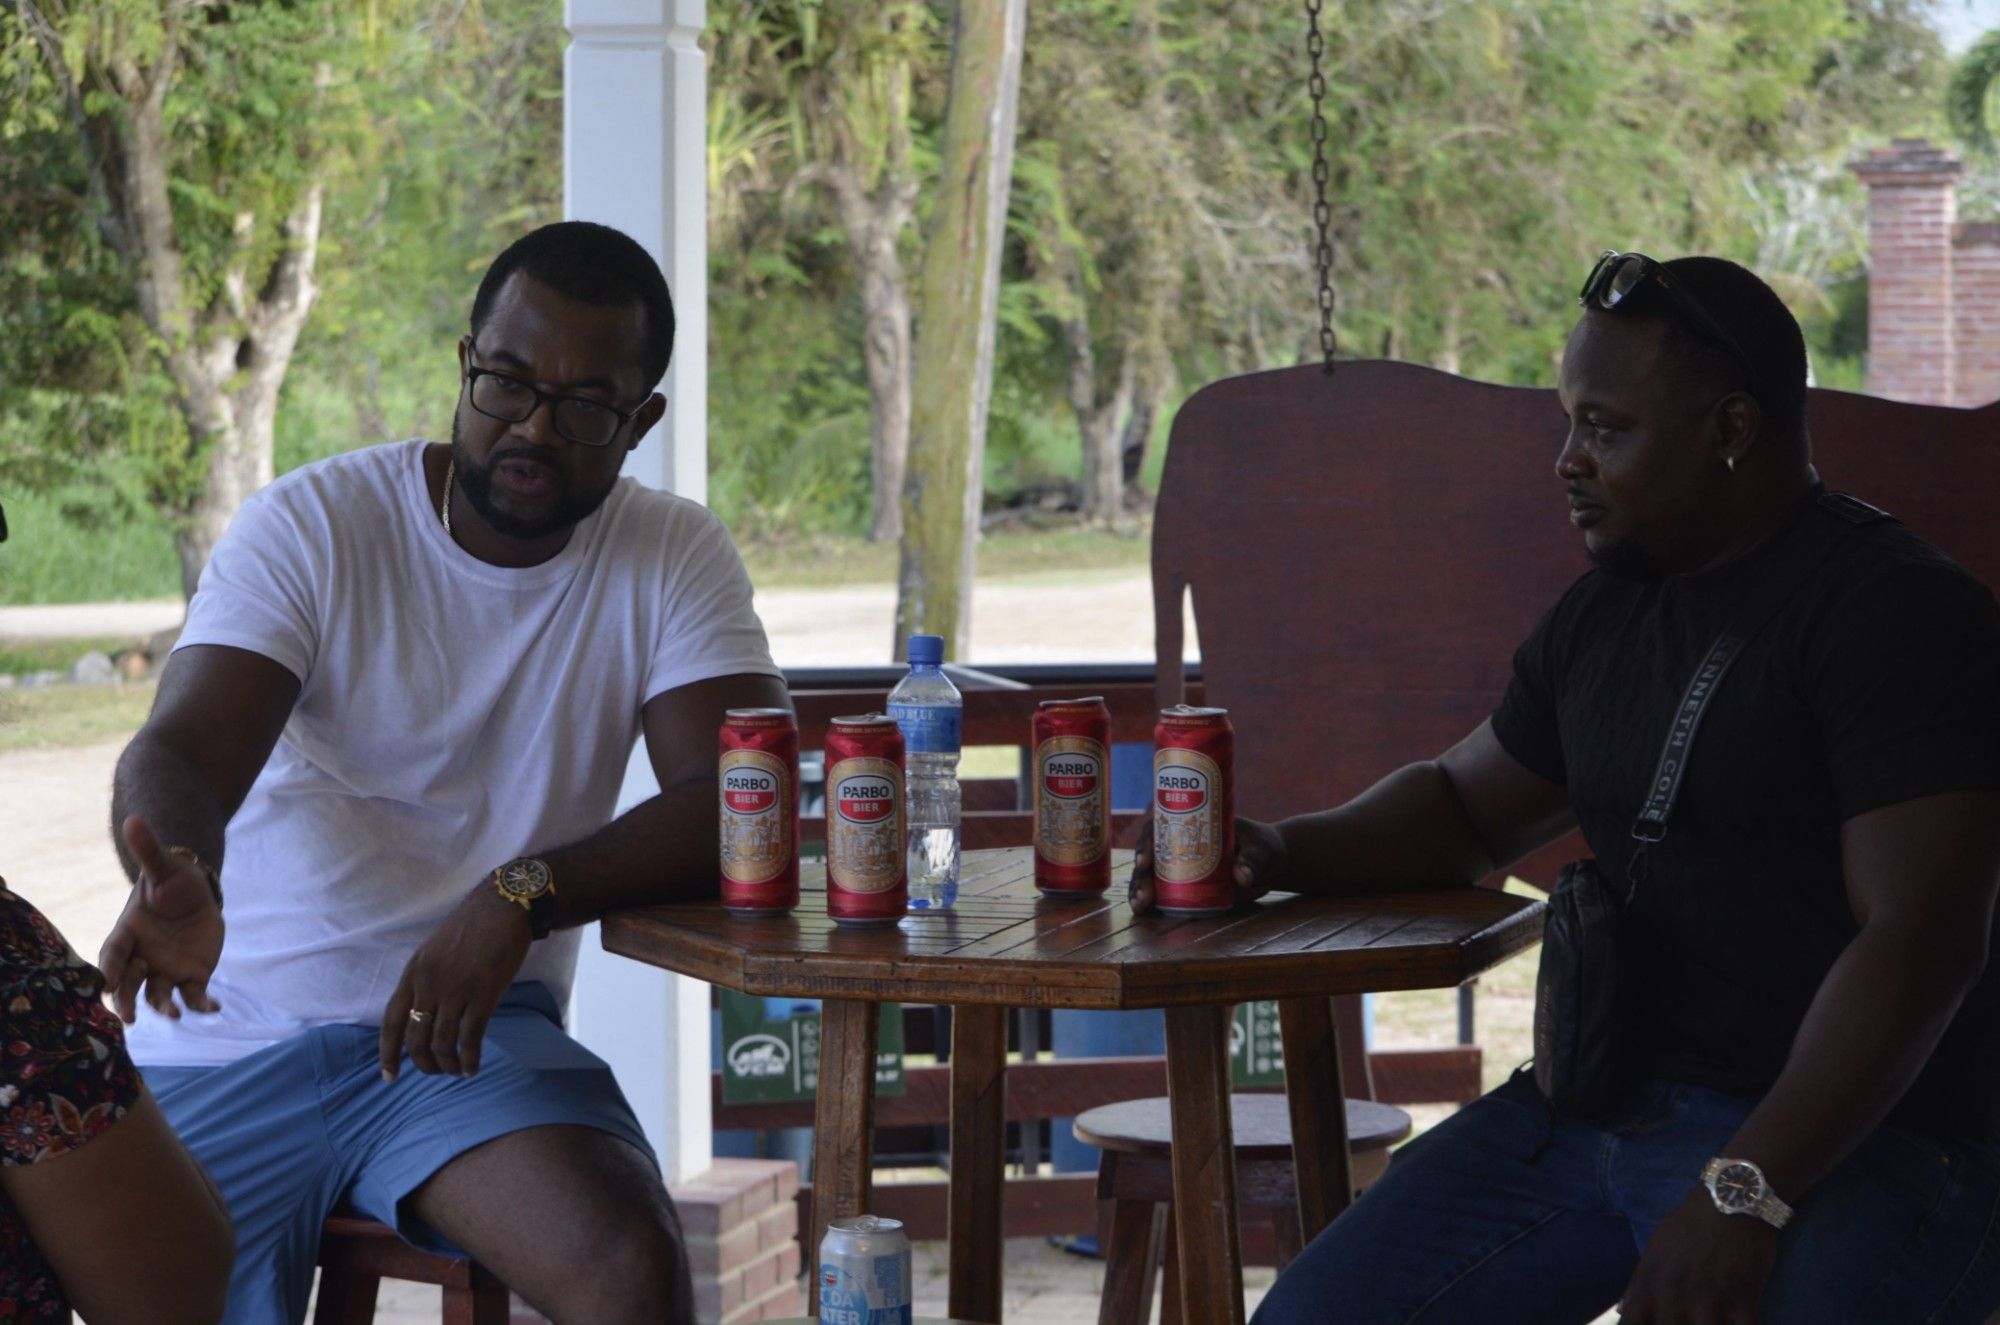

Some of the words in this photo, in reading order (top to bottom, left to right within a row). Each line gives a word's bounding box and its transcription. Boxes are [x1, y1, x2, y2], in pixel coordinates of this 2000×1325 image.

[907, 707, 935, 720] BLUE
[1049, 763, 1093, 774] PARBO
[726, 778, 769, 790] PARBO
[1057, 778, 1084, 789] BIER
[1159, 777, 1199, 790] PARBO
[843, 786, 889, 798] PARBO
[734, 793, 759, 804] BIER
[1165, 793, 1189, 803] BIER
[852, 801, 879, 812] BIER
